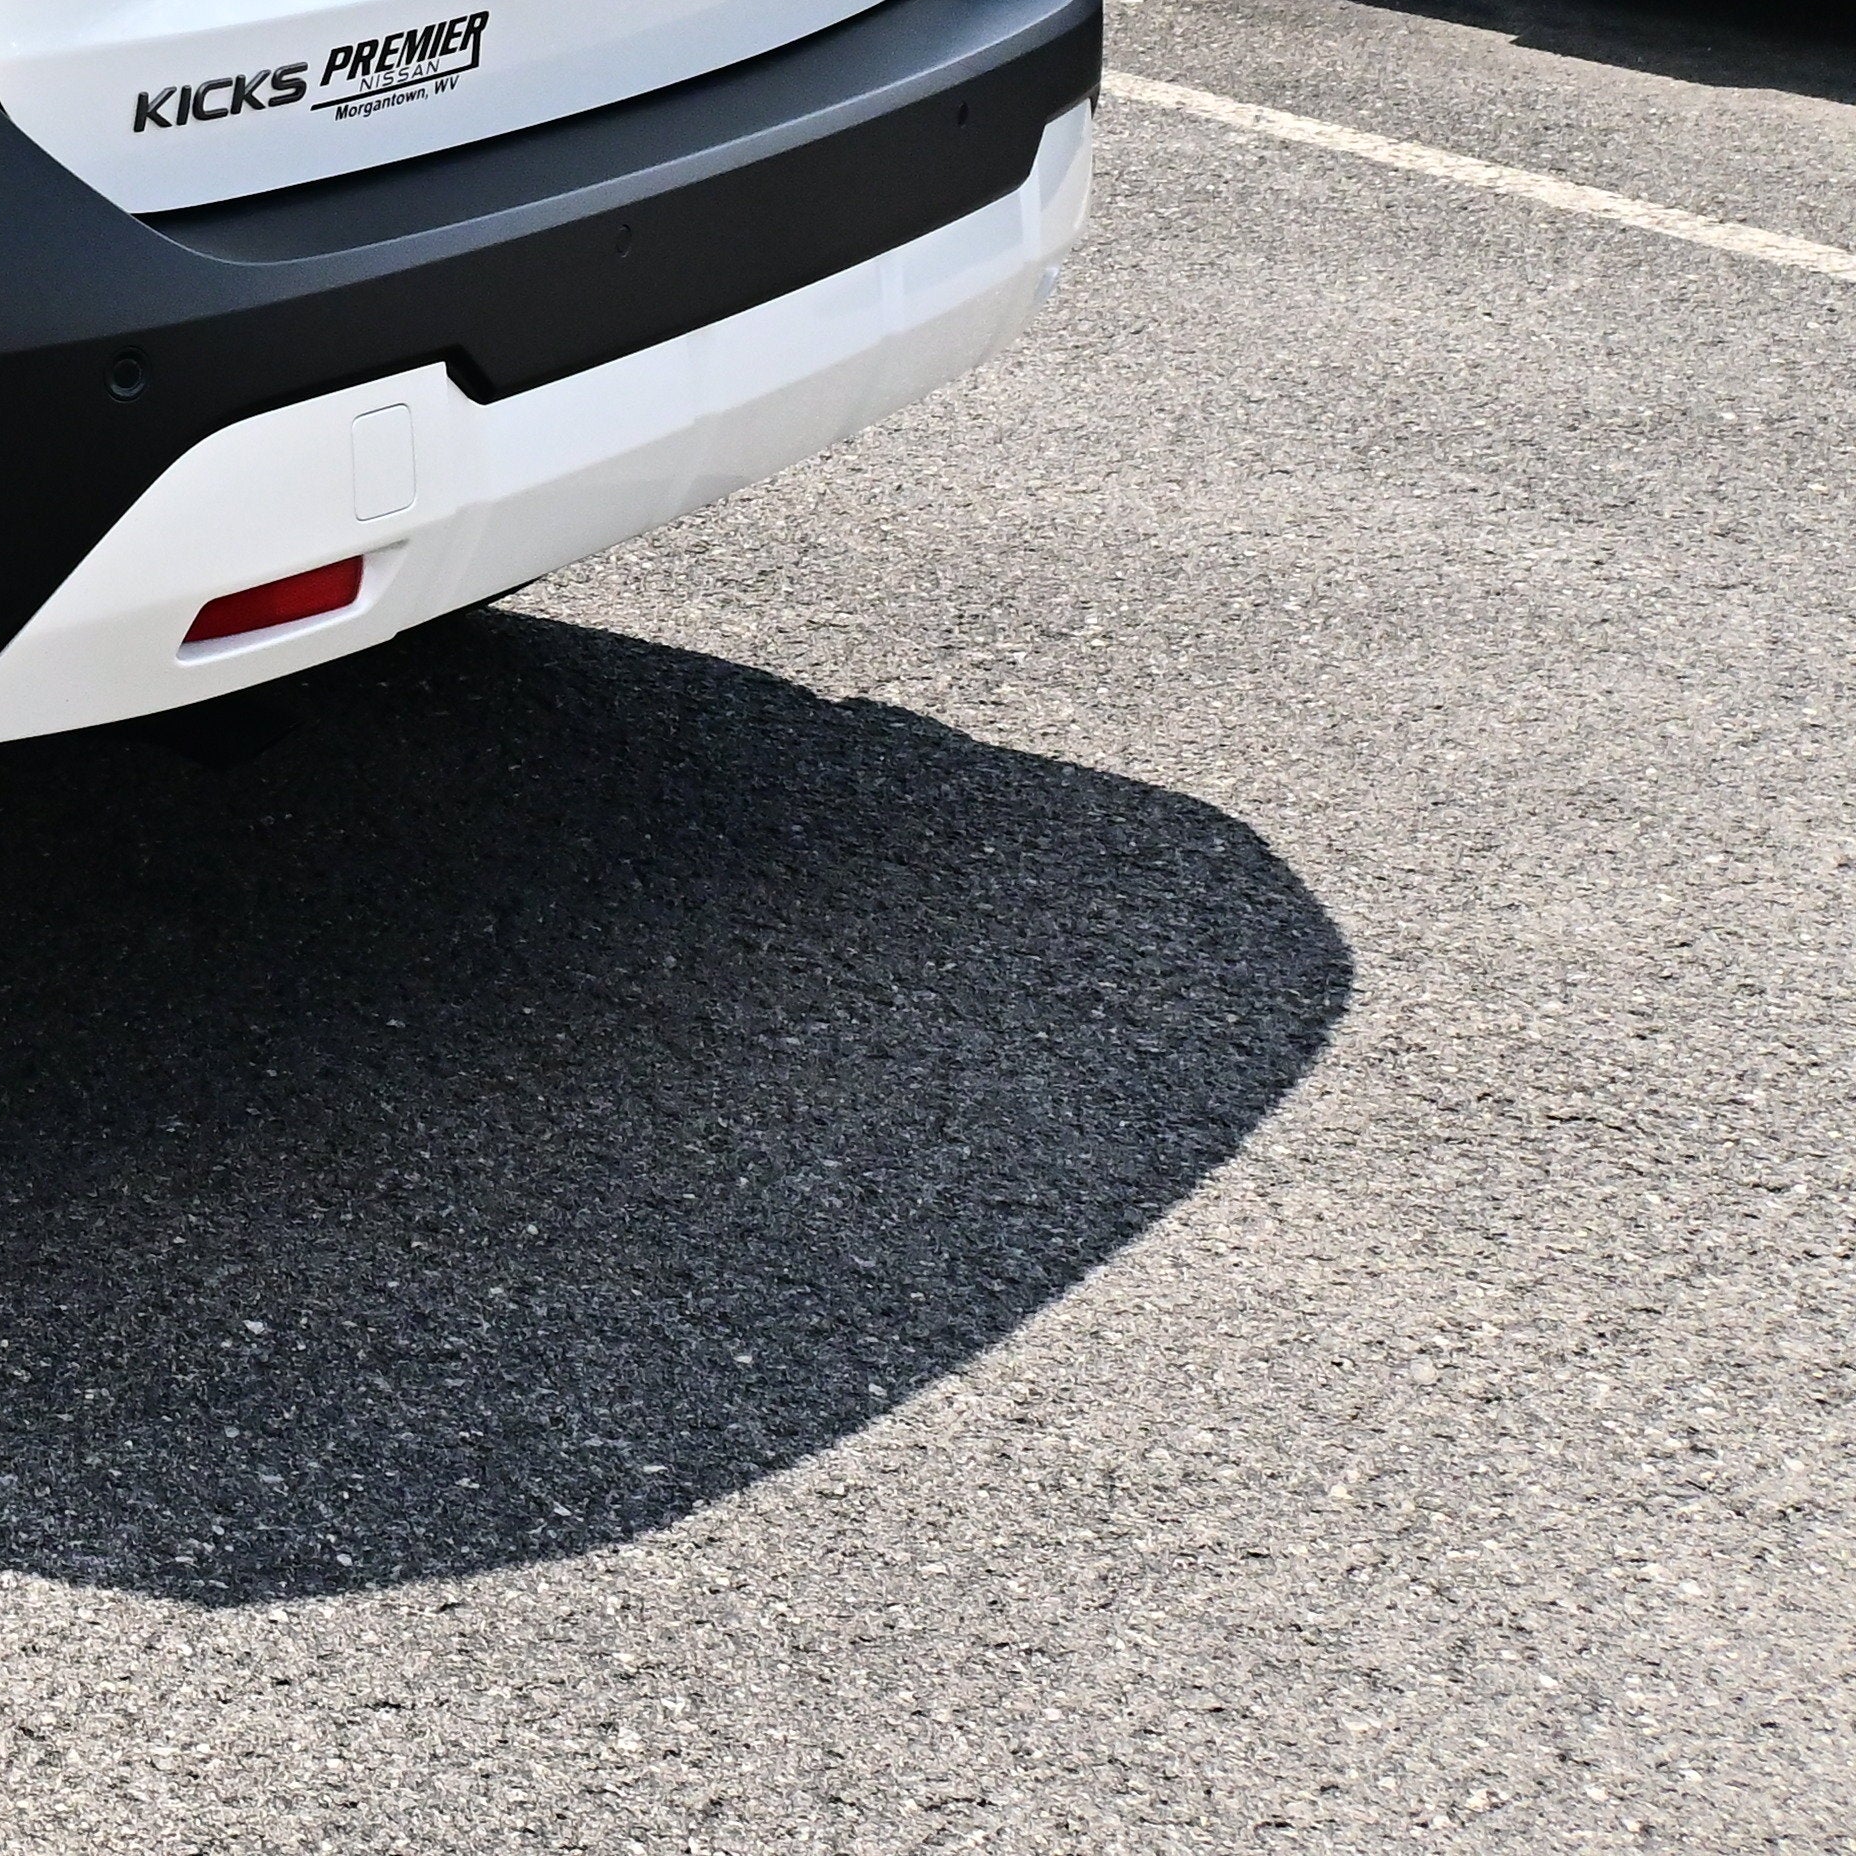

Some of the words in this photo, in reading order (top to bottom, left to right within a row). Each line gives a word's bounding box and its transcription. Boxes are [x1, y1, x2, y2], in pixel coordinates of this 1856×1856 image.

[319, 10, 490, 86] PREMIER
[359, 59, 440, 92] NISSAN
[133, 61, 309, 133] KICKS
[335, 87, 429, 121] Morgantown,
[434, 75, 460, 95] WV
